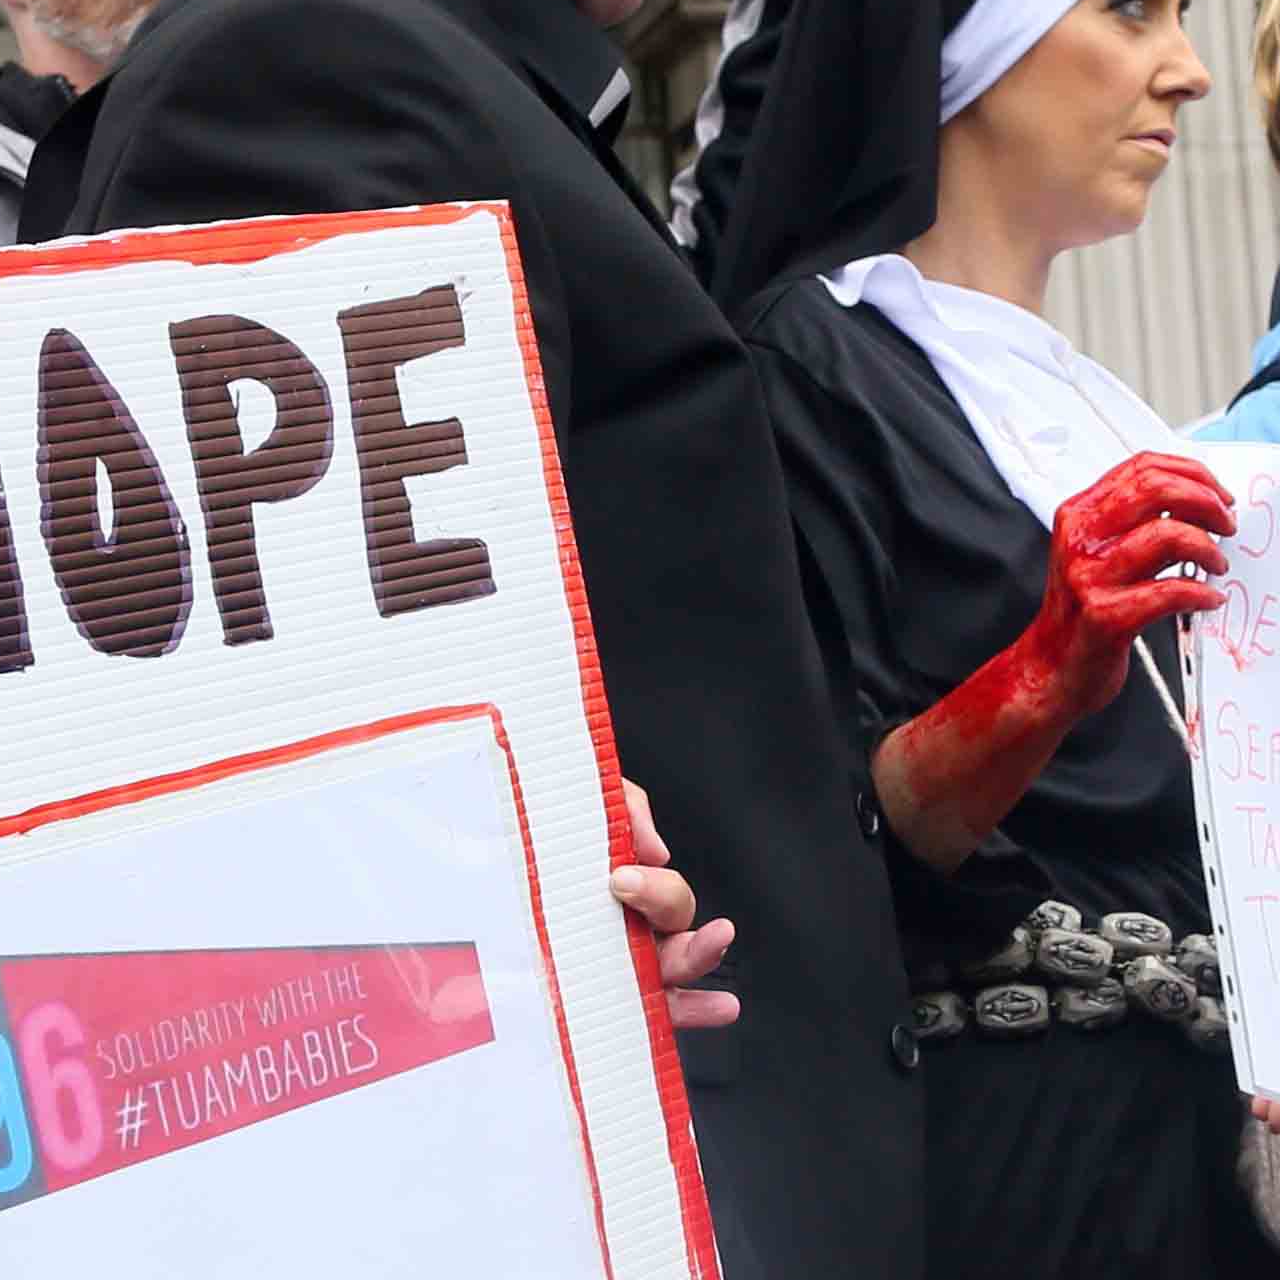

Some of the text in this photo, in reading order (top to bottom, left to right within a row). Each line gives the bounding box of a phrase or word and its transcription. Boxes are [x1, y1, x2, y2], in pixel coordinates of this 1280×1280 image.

[95, 961, 368, 1080] SOLIDARITY WITH THE
[114, 1013, 380, 1150] #TUAMBABIES
